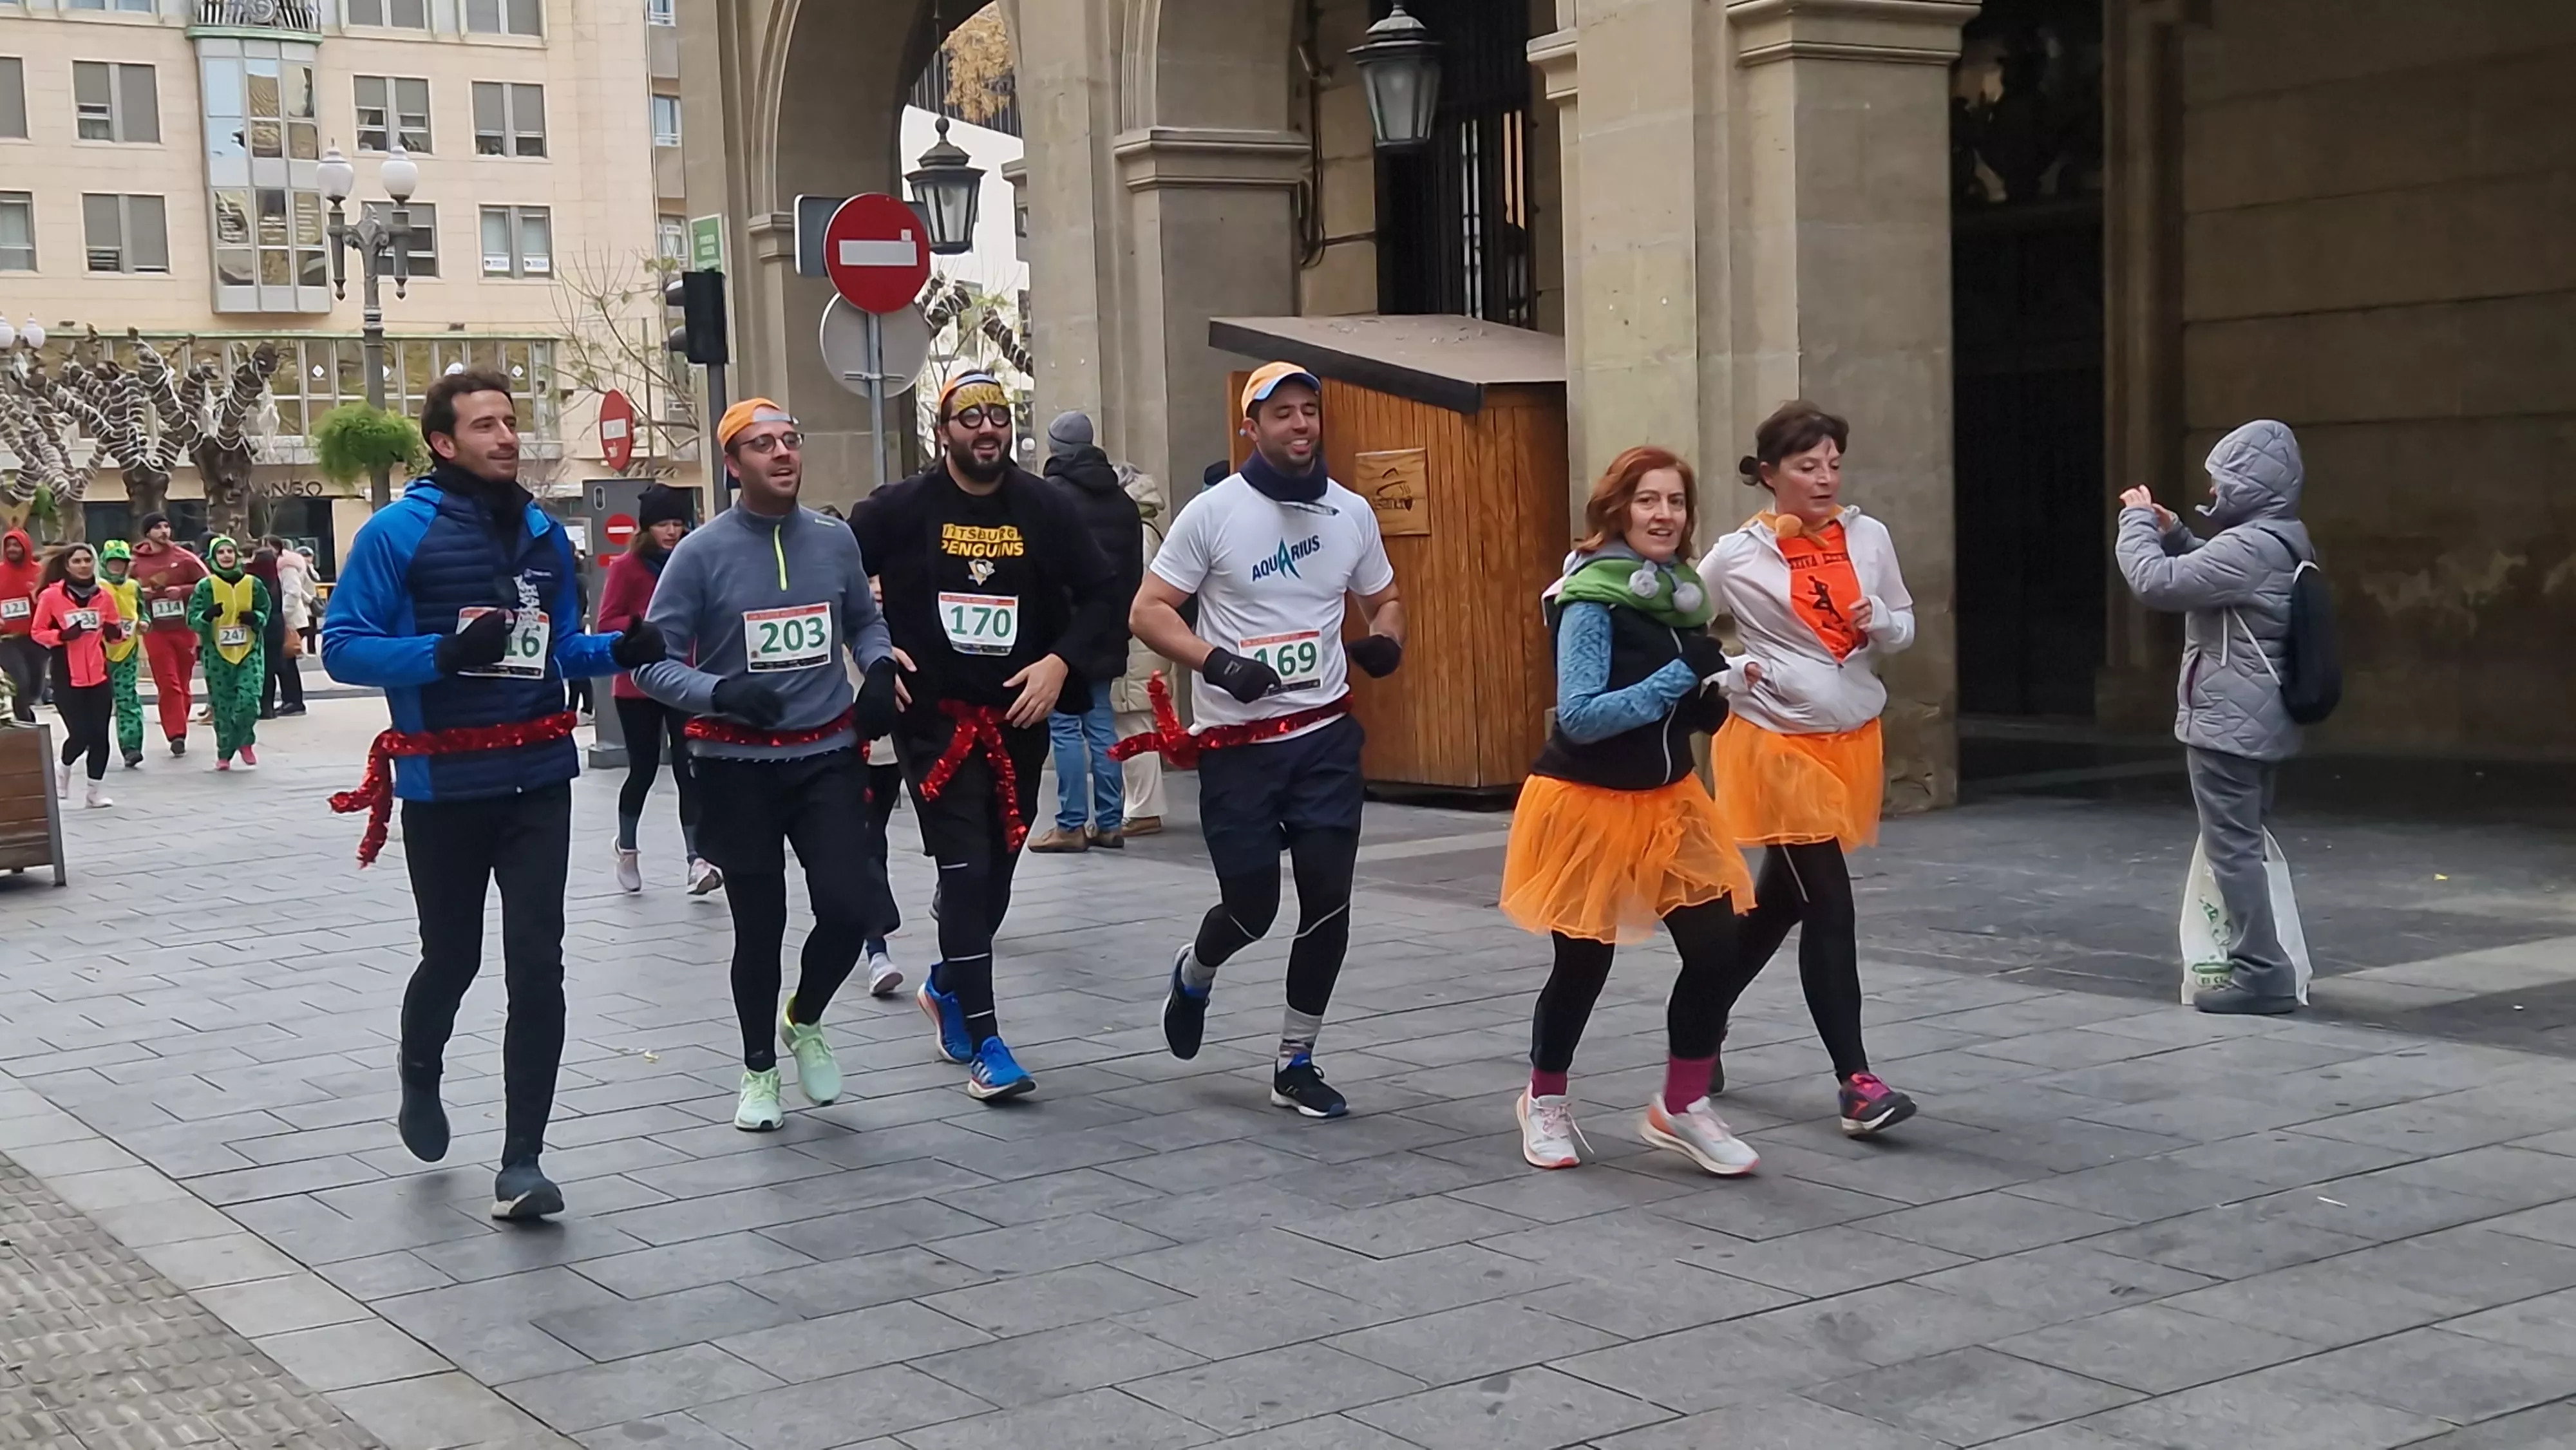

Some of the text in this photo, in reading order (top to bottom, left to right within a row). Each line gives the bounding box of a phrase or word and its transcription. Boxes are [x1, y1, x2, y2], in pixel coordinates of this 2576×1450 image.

[1252, 535, 1320, 582] AQUARIUS
[5, 601, 27, 615] 123
[158, 601, 181, 614] 114
[951, 605, 1012, 637] 170
[220, 629, 245, 641] 247
[759, 616, 826, 654] 203
